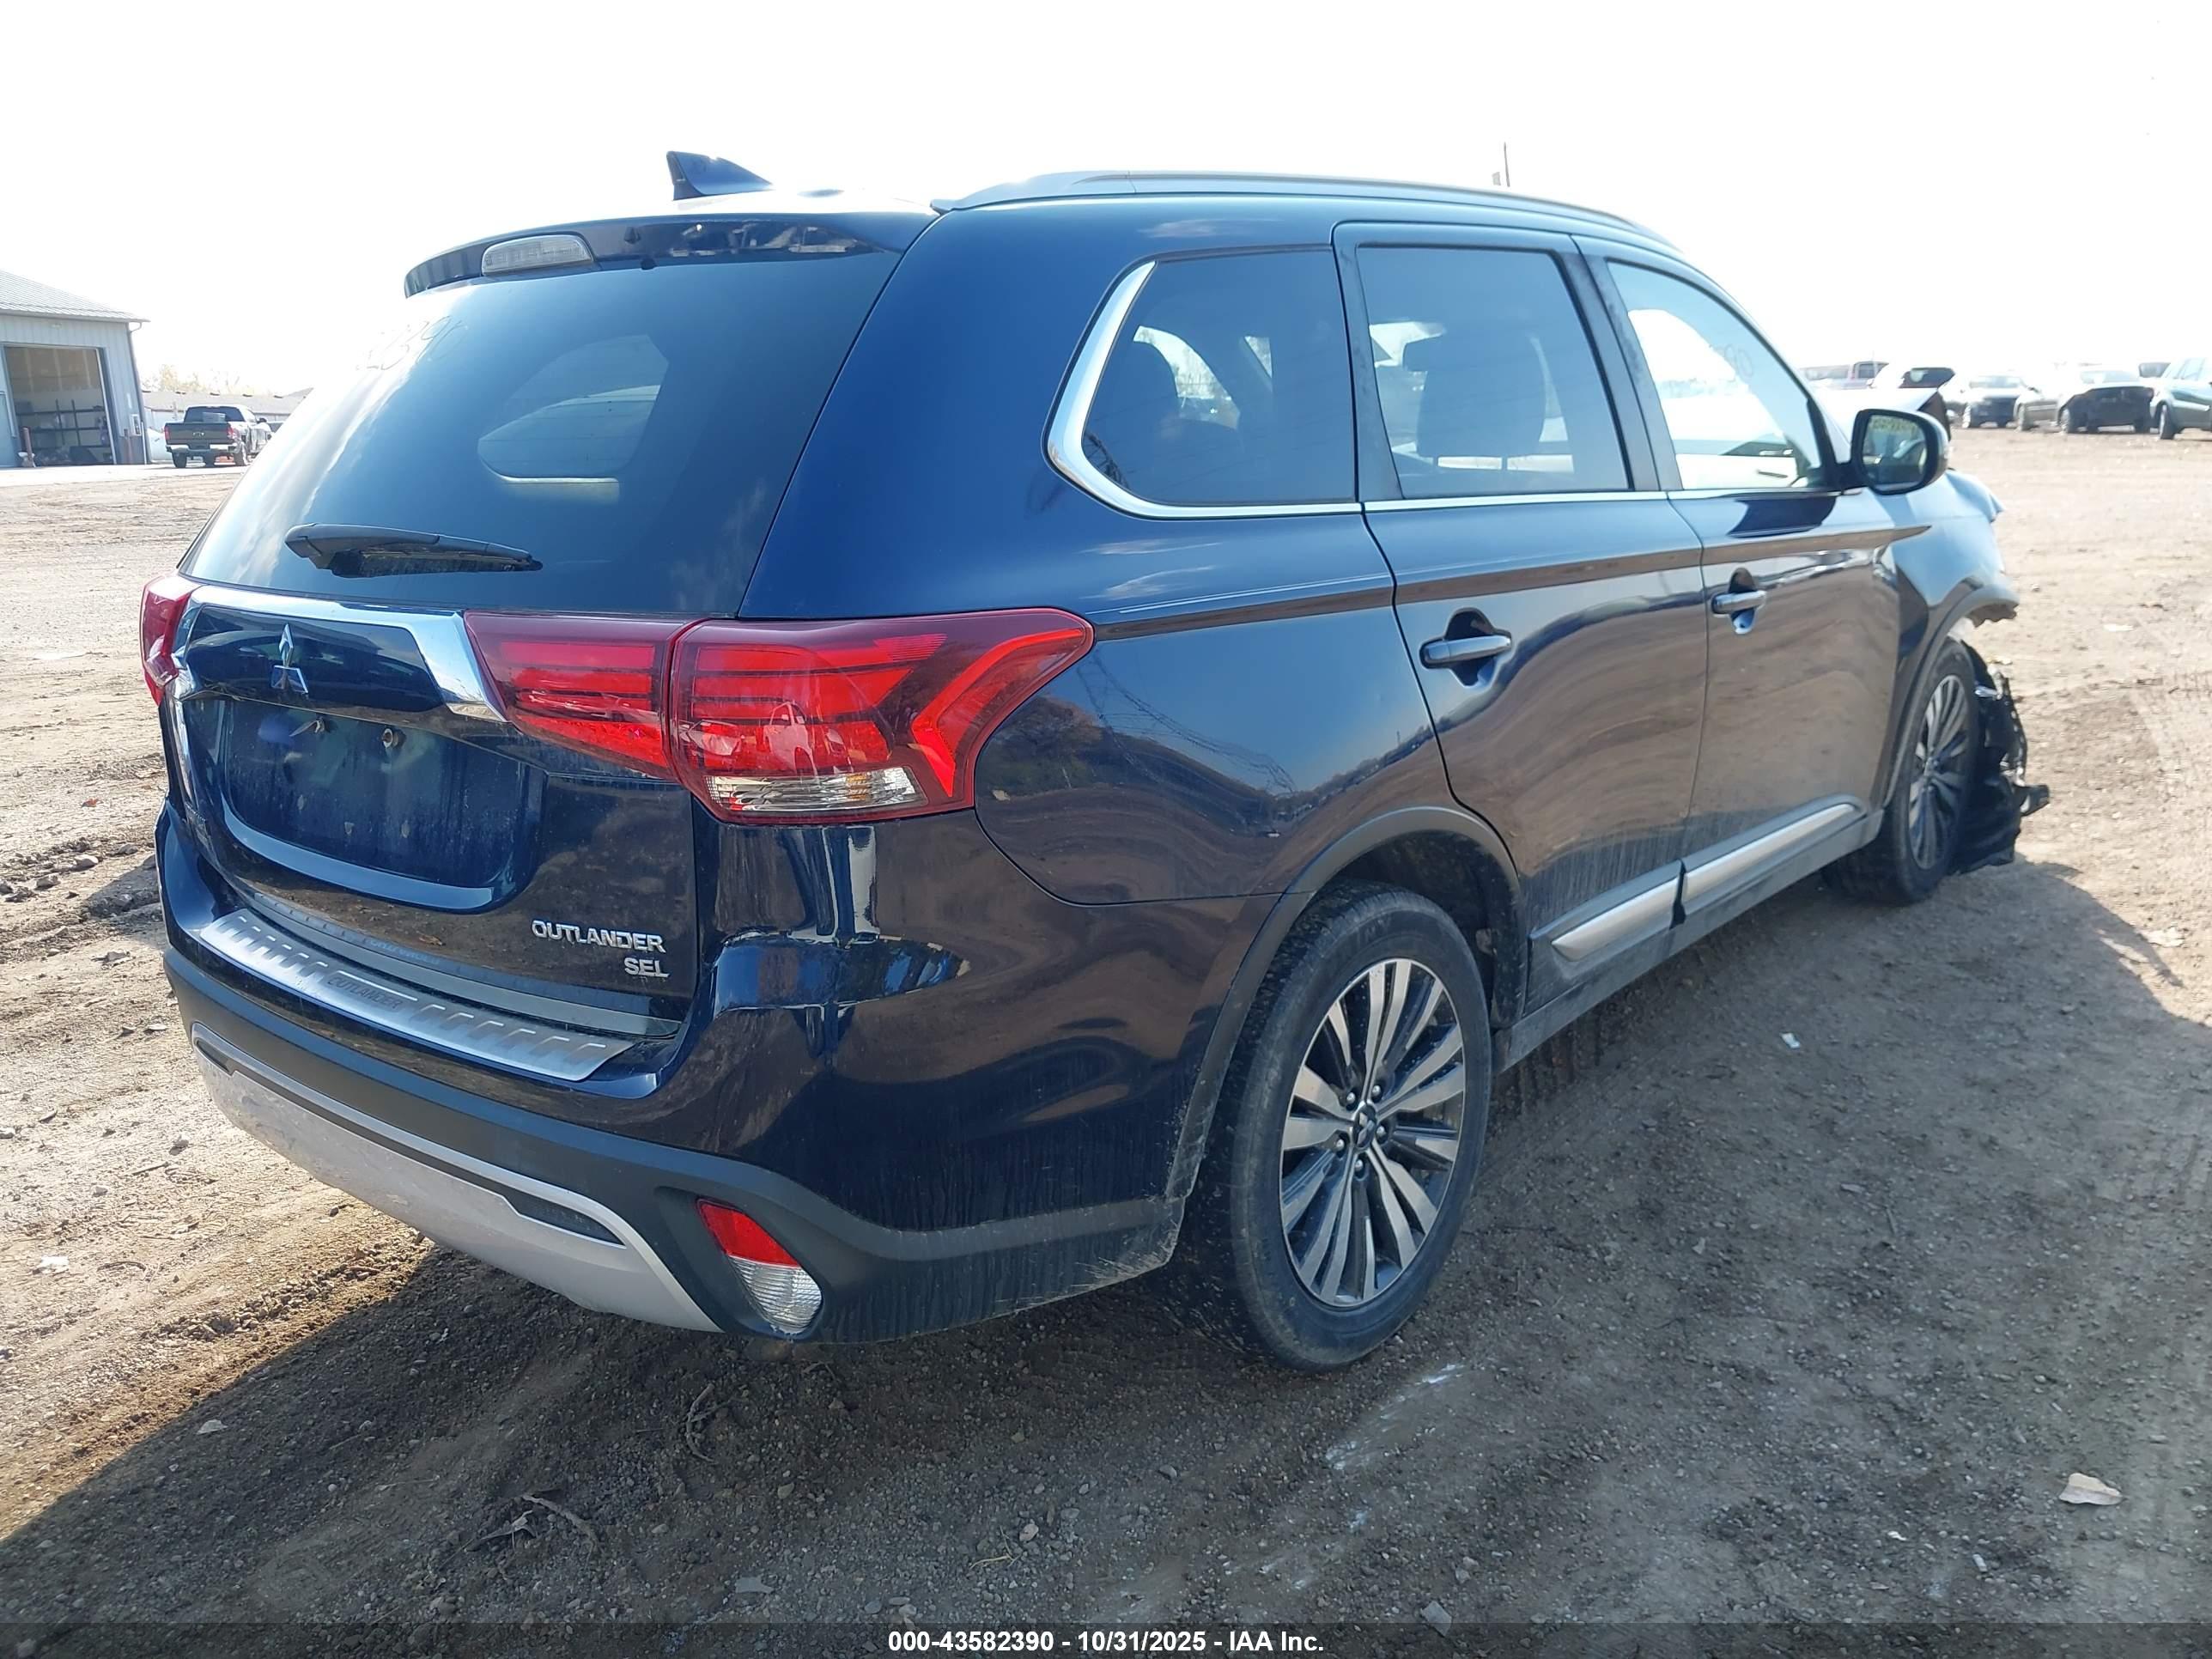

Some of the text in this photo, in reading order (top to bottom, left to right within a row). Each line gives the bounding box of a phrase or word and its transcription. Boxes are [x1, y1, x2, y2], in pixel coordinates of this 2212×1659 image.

[531, 919, 666, 954] OUTLANDER
[623, 957, 670, 979] SEL
[327, 975, 404, 1010] OUTLANDER
